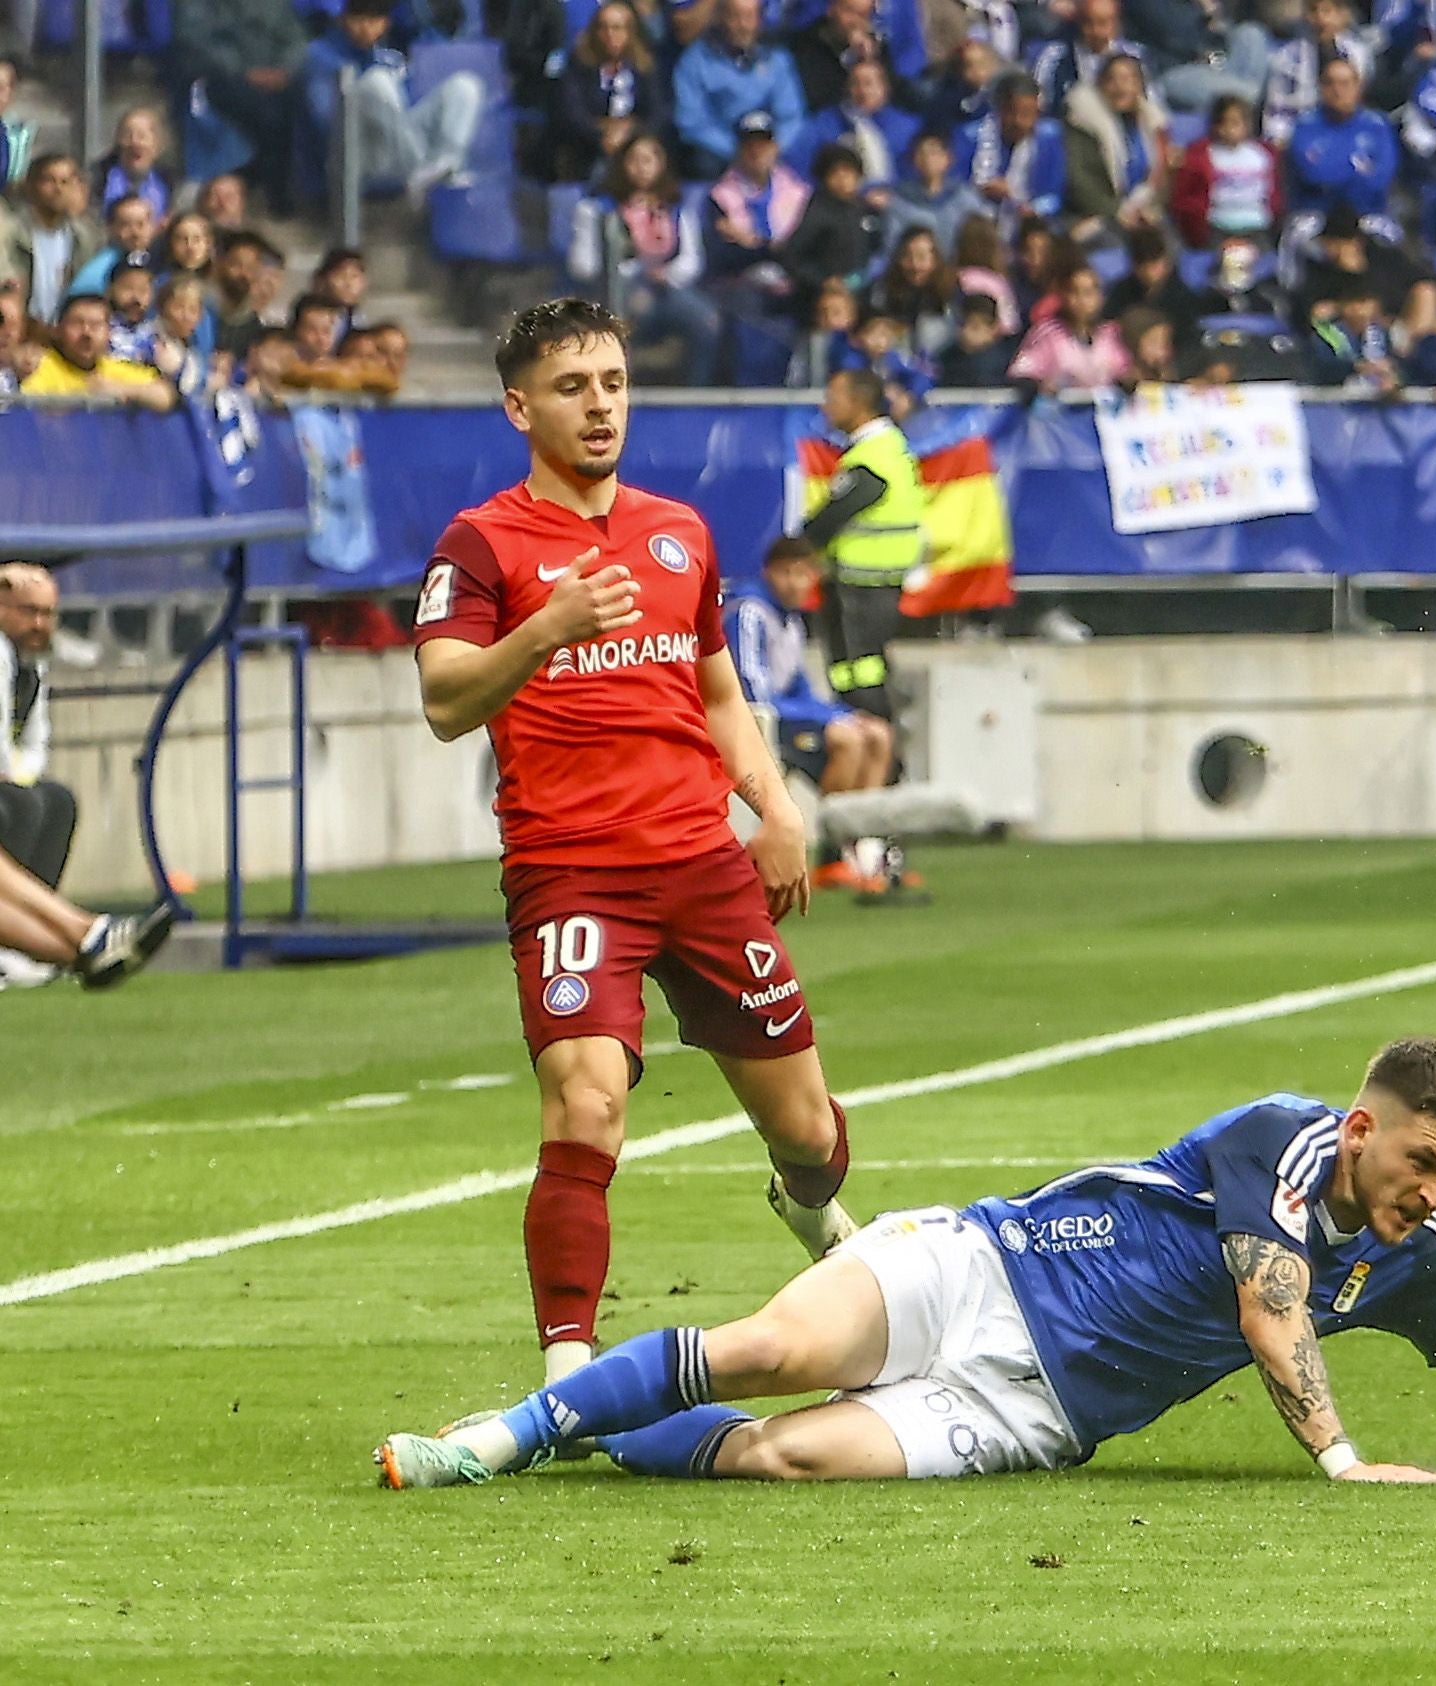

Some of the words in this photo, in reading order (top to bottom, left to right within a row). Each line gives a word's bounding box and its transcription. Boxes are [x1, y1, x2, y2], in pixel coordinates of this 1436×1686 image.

[577, 632, 699, 675] MORABANC
[536, 915, 601, 979] 10
[740, 978, 799, 1010] Andorr
